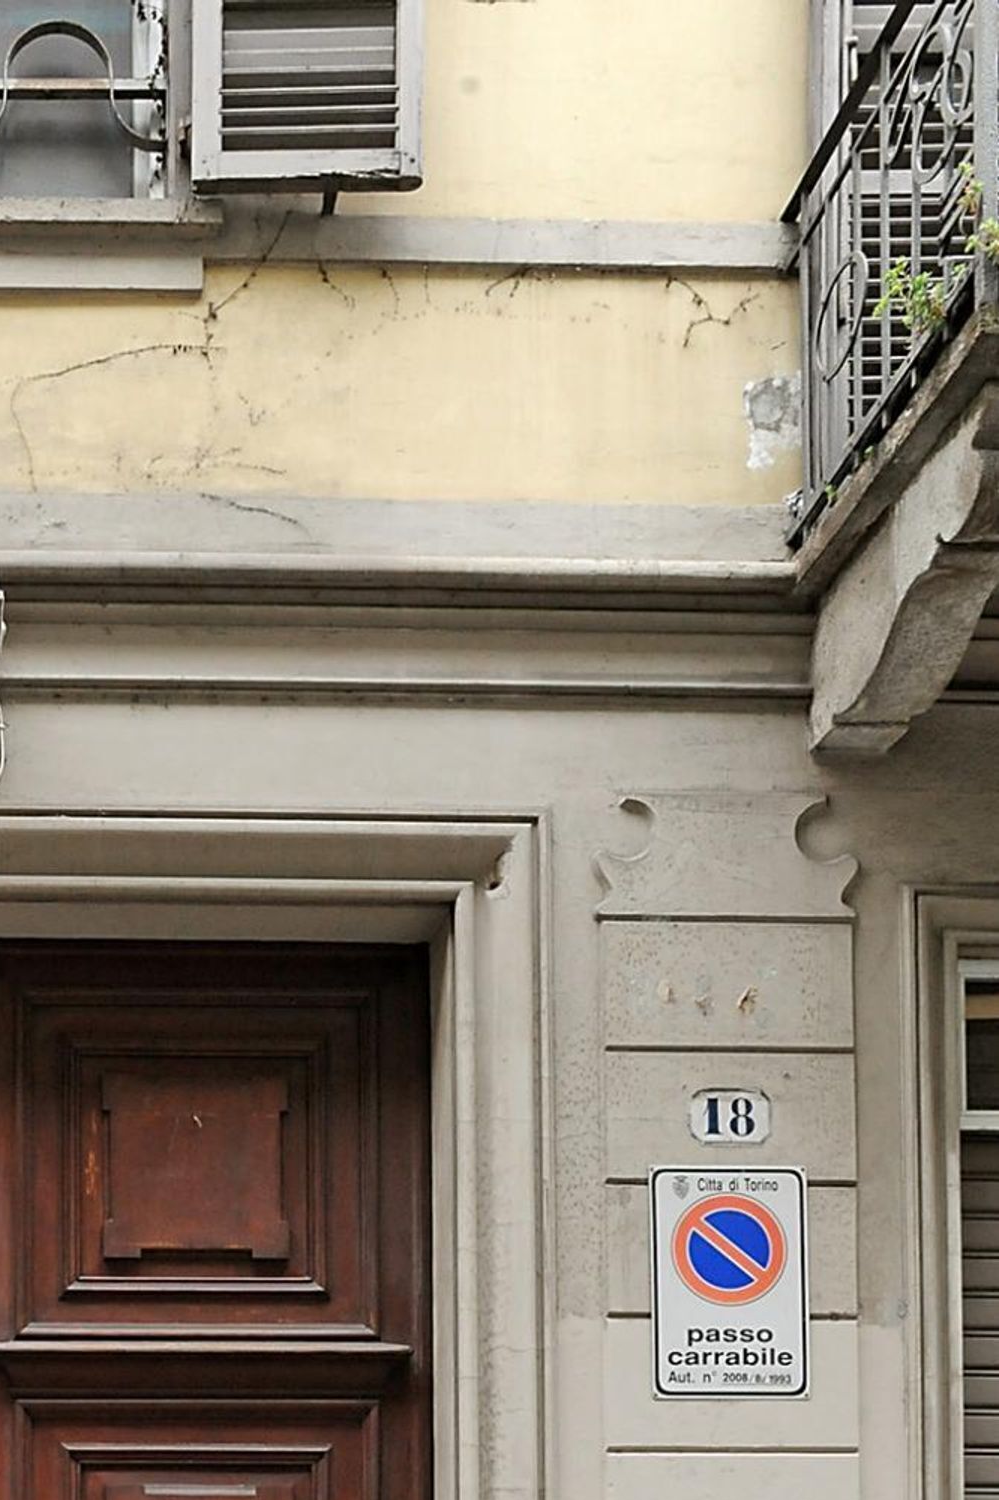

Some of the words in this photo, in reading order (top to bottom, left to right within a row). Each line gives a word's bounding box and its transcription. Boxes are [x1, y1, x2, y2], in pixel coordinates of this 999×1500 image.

[702, 1096, 757, 1137] 18
[728, 1177, 739, 1191] di
[744, 1177, 779, 1191] Torino
[687, 1328, 773, 1347] passo
[668, 1348, 793, 1366] carrabile
[668, 1372, 695, 1384] Aut.
